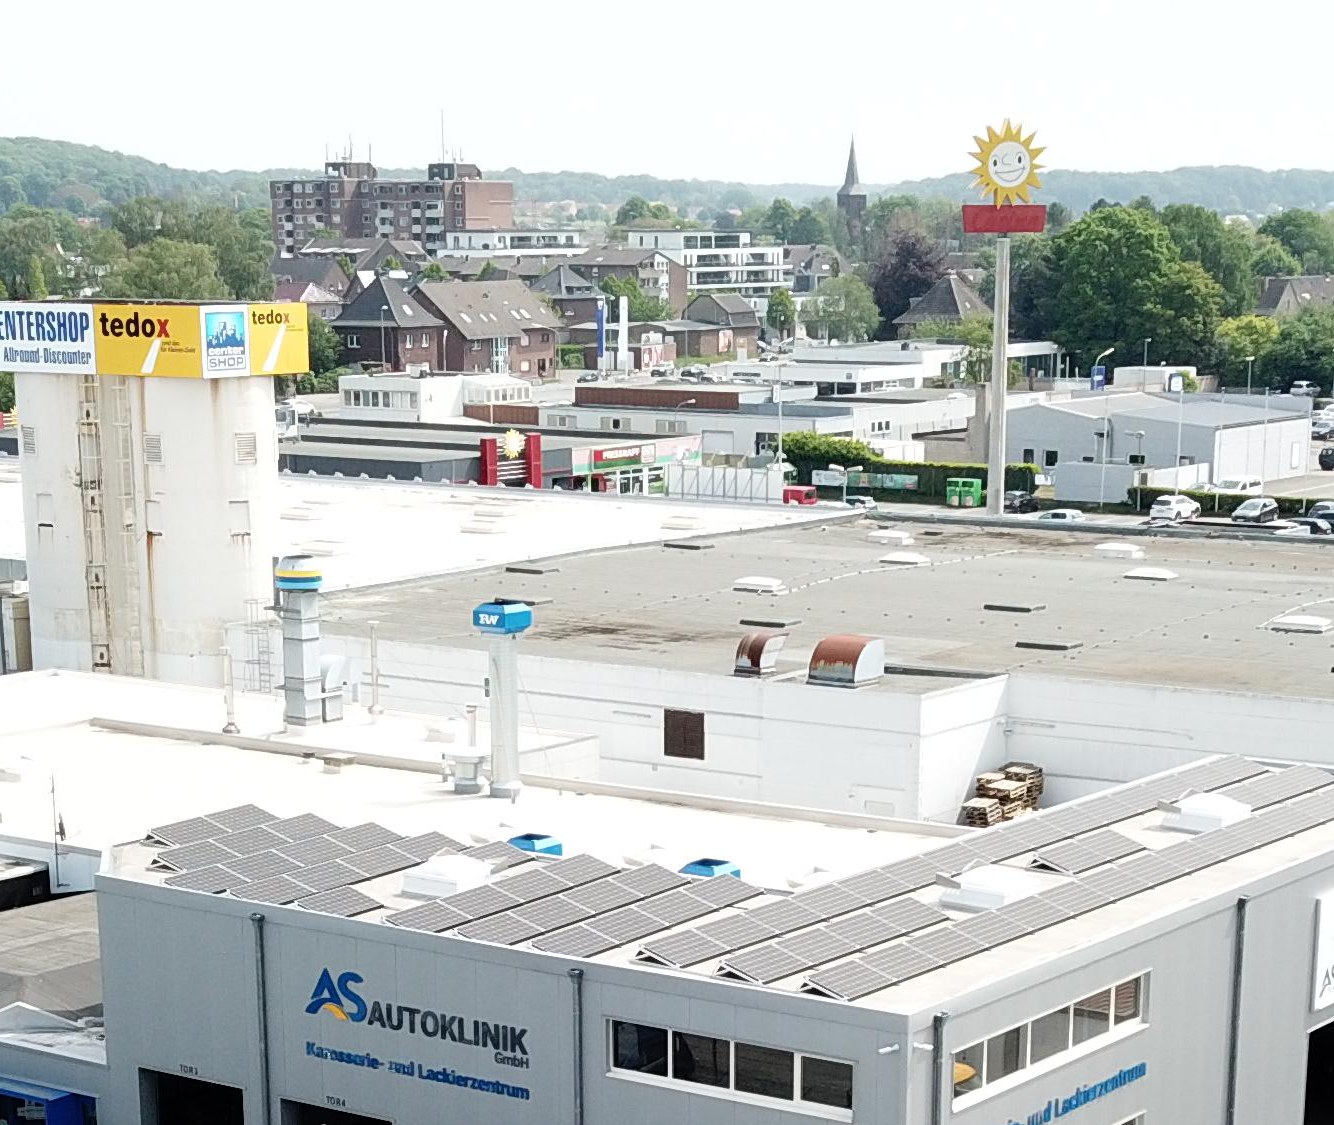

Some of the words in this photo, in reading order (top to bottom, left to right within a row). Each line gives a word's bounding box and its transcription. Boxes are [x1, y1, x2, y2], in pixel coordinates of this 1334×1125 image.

[99, 311, 170, 338] tedox
[252, 309, 290, 325] tedox
[209, 357, 244, 368] SHOP
[305, 967, 368, 1023] AS
[367, 1000, 528, 1056] AUTOKLINIK
[179, 1063, 194, 1075] TOR
[494, 1051, 530, 1070] GmbH
[305, 1040, 385, 1070] Karosserie-
[388, 1054, 415, 1077] und
[417, 1063, 531, 1101] Lackierzentrum
[1054, 1061, 1147, 1118] Lackierzentrum
[326, 1095, 341, 1107] TOR
